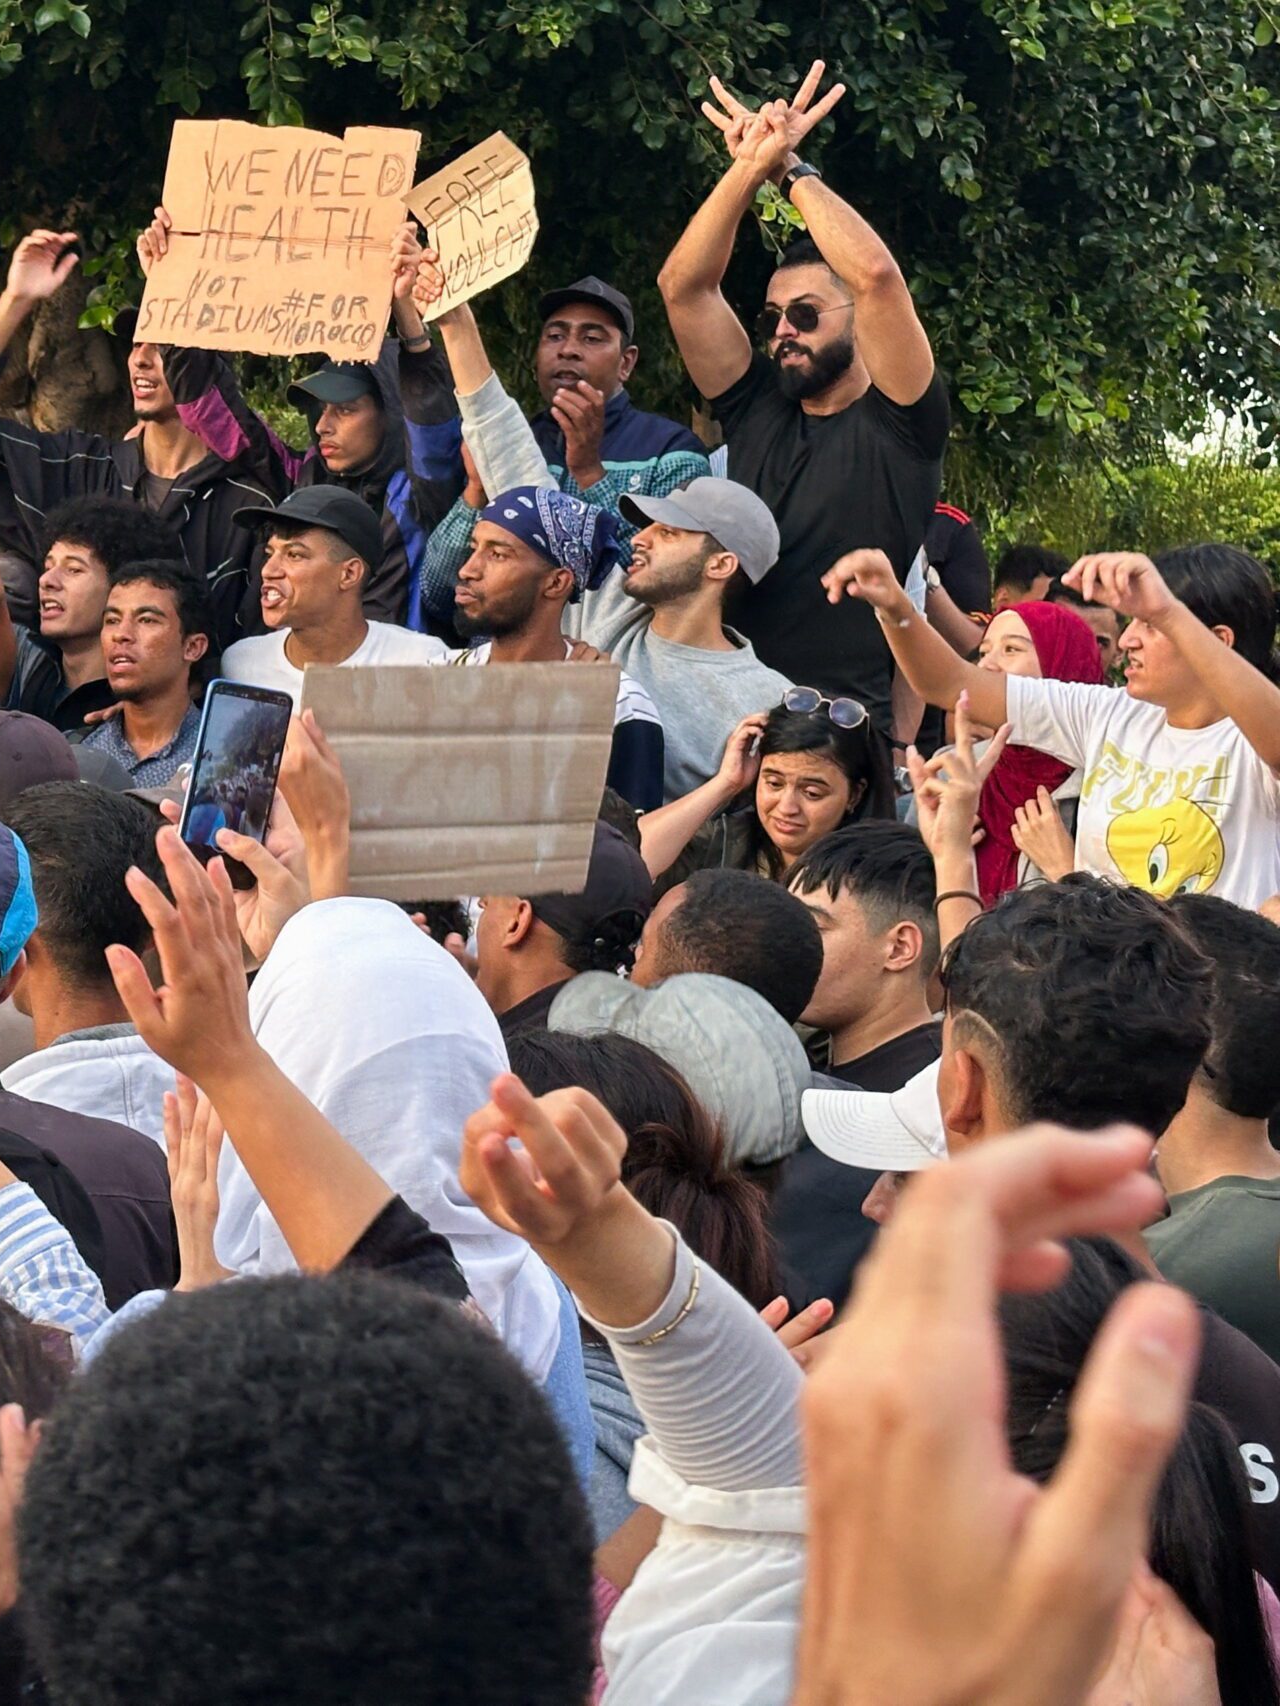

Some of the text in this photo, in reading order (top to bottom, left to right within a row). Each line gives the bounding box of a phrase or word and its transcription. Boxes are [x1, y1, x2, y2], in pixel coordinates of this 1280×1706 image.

[204, 147, 407, 198] WE NEED
[424, 154, 516, 258] FREE
[200, 200, 375, 269] HEALTH
[189, 268, 247, 299] NOT
[140, 297, 284, 335] STADIUMS
[281, 288, 369, 321] #FOR
[272, 315, 377, 351] MOROCCO
